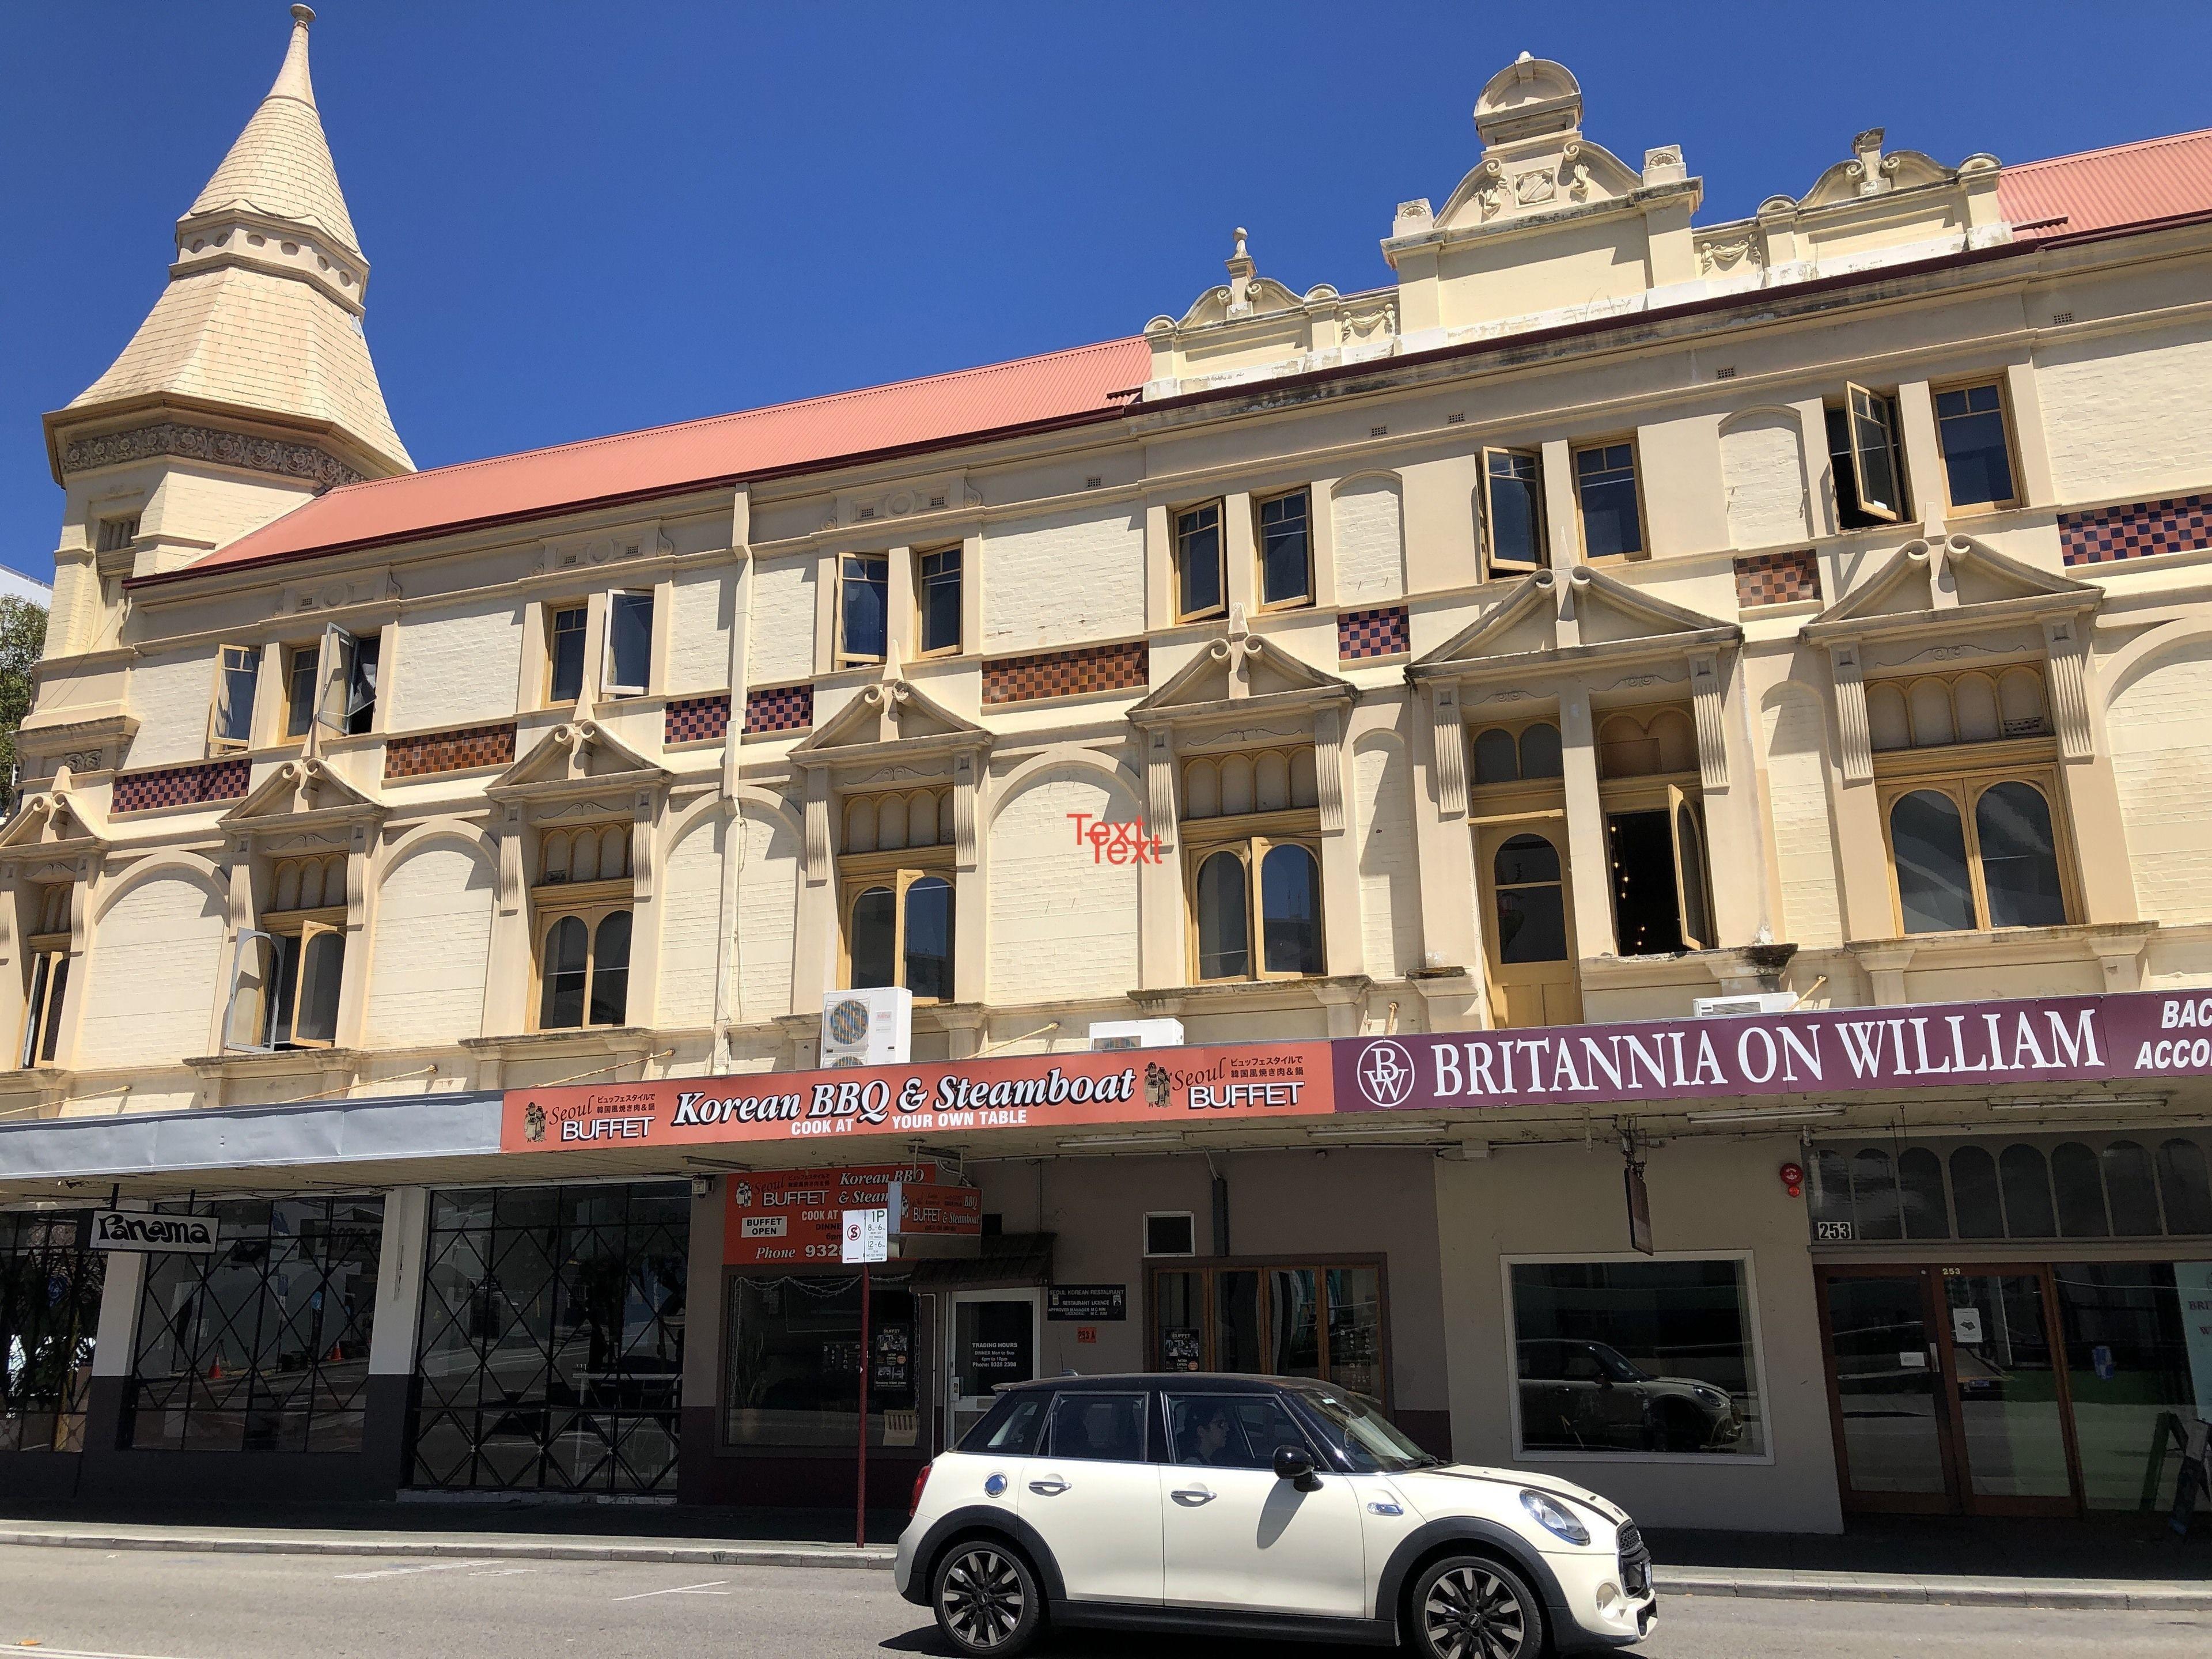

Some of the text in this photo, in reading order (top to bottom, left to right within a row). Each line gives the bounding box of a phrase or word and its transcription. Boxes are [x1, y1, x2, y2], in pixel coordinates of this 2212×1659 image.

[1230, 1055, 1303, 1067] ビュッフェスタイルで
[1430, 1009, 2105, 1097] BRITANNIA ON WILLIAM
[2134, 1039, 2212, 1069] ACCO
[1172, 1057, 1226, 1090] Seoul
[597, 1093, 656, 1104] ビュッフェスタイルで
[671, 1067, 1137, 1127] Korean BBQ & Steamboat
[1188, 1081, 1305, 1109] BUFFET
[549, 1094, 595, 1125] Seoul
[561, 1116, 656, 1142] BUFFET
[791, 1109, 1027, 1135] COOK AT YOUR OWN TABLE
[753, 1173, 787, 1195] Seoul
[839, 1172, 889, 1185] Korean
[763, 1189, 830, 1207] BUFFET
[838, 1191, 850, 1204] &
[964, 1196, 978, 1211] BBQ
[747, 1218, 782, 1226] BUFFET
[801, 1210, 839, 1221] COOK AT
[872, 1210, 885, 1222] 1P
[912, 1207, 980, 1225] BUFFET & Steamboat
[98, 1214, 211, 1244] Panama
[1820, 1223, 1850, 1238] 253
[755, 1246, 796, 1259] Phone
